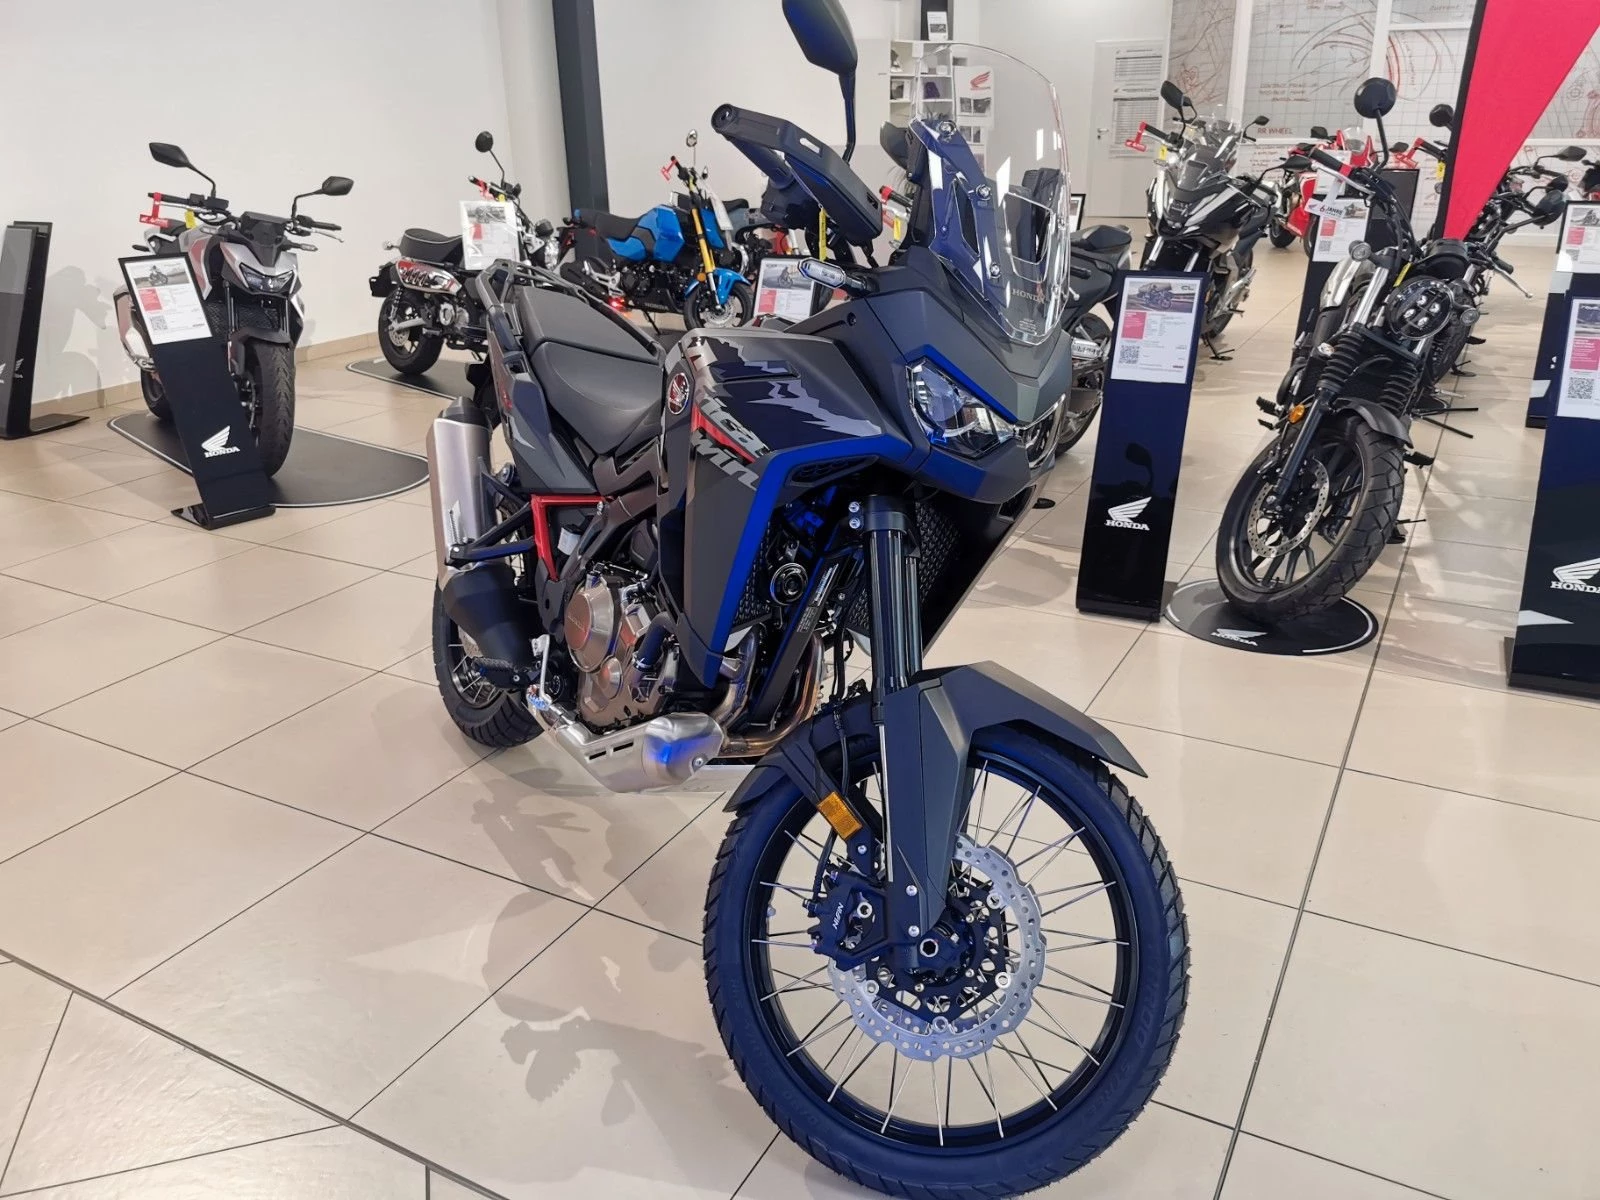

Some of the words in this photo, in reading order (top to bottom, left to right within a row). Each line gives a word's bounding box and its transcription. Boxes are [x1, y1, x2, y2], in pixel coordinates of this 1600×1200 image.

[1012, 288, 1046, 304] HONDA
[203, 446, 241, 458] HONDA
[1104, 519, 1150, 531] HONDA
[1210, 631, 1258, 647] HONDA
